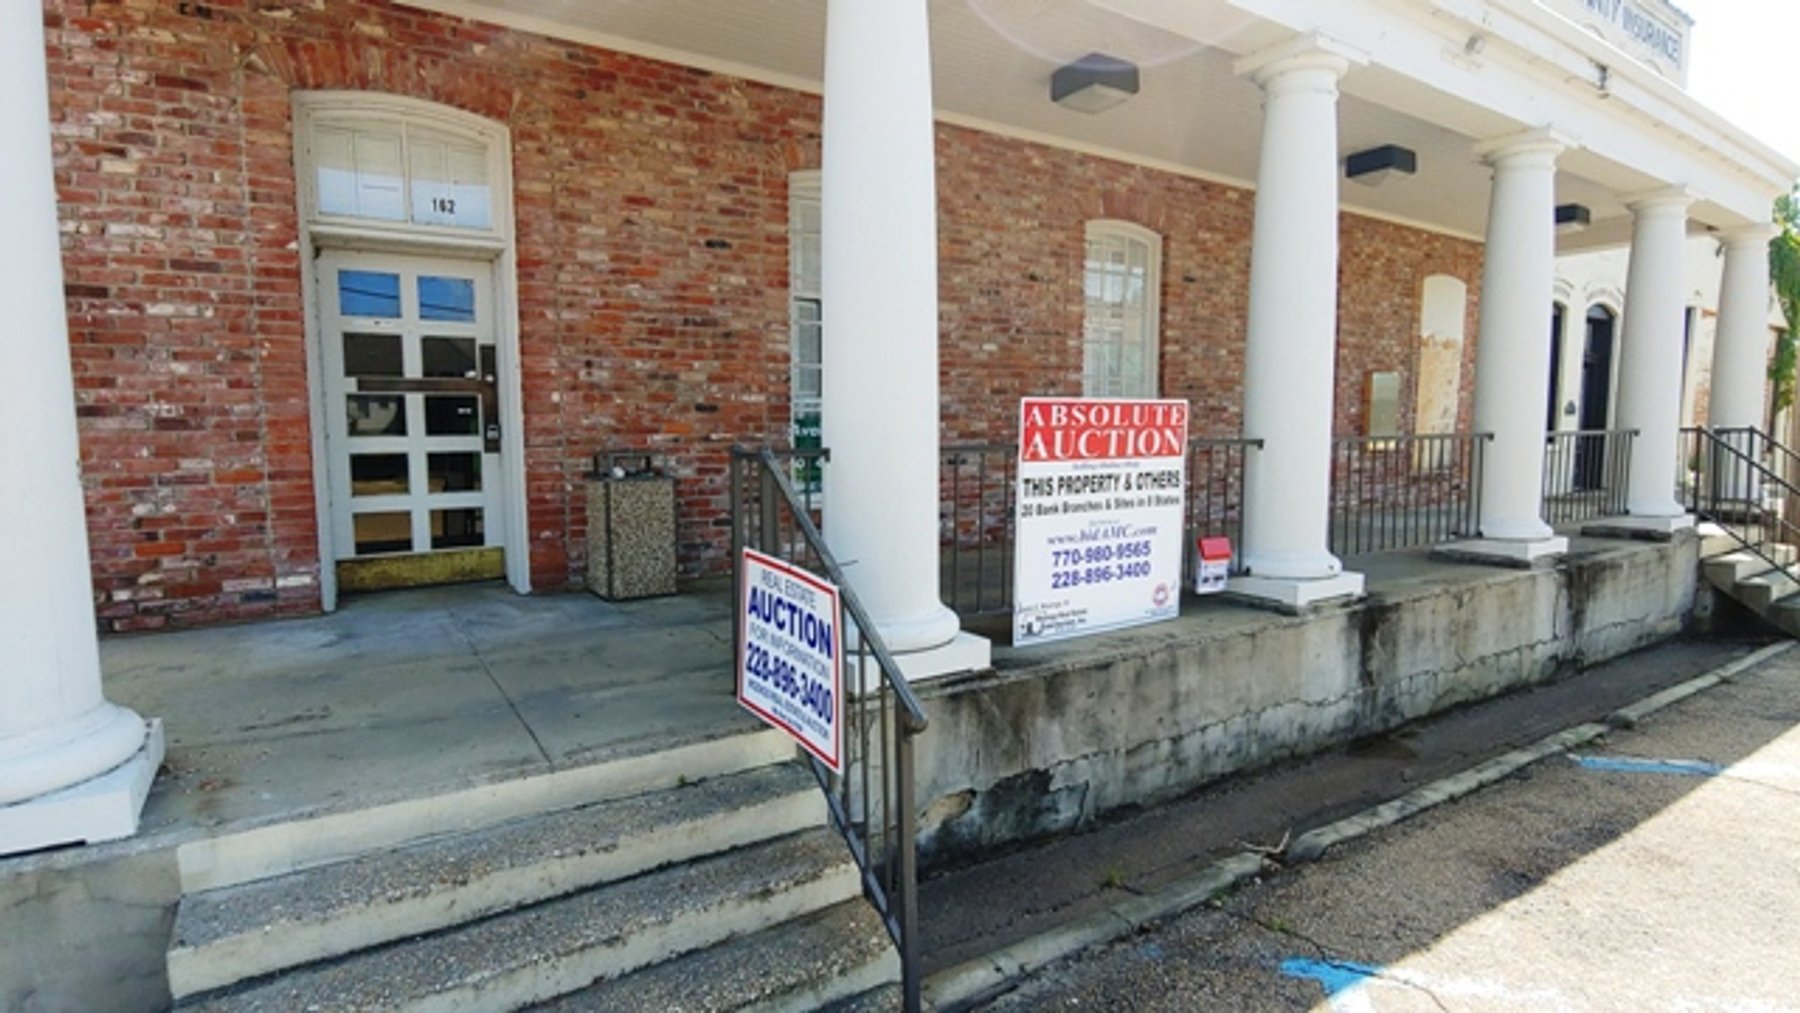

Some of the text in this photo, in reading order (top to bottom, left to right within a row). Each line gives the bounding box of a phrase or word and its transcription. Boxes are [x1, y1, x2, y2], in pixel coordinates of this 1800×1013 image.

[432, 197, 456, 215] 162
[1025, 404, 1186, 428] ABSOLUTE
[1024, 427, 1184, 460] AUCTION
[1023, 469, 1180, 498] THIS PROPERTY & OTHERS
[1036, 501, 1059, 517] Bank
[1062, 498, 1104, 514] Branches
[1114, 496, 1135, 510] Sites
[1052, 540, 1151, 567] 770-980-9565
[1051, 560, 1151, 589] 228-896-3400
[761, 568, 817, 611] REAL ESTATE
[747, 586, 833, 660] AUCTION
[745, 641, 834, 725] 228-896-3400
